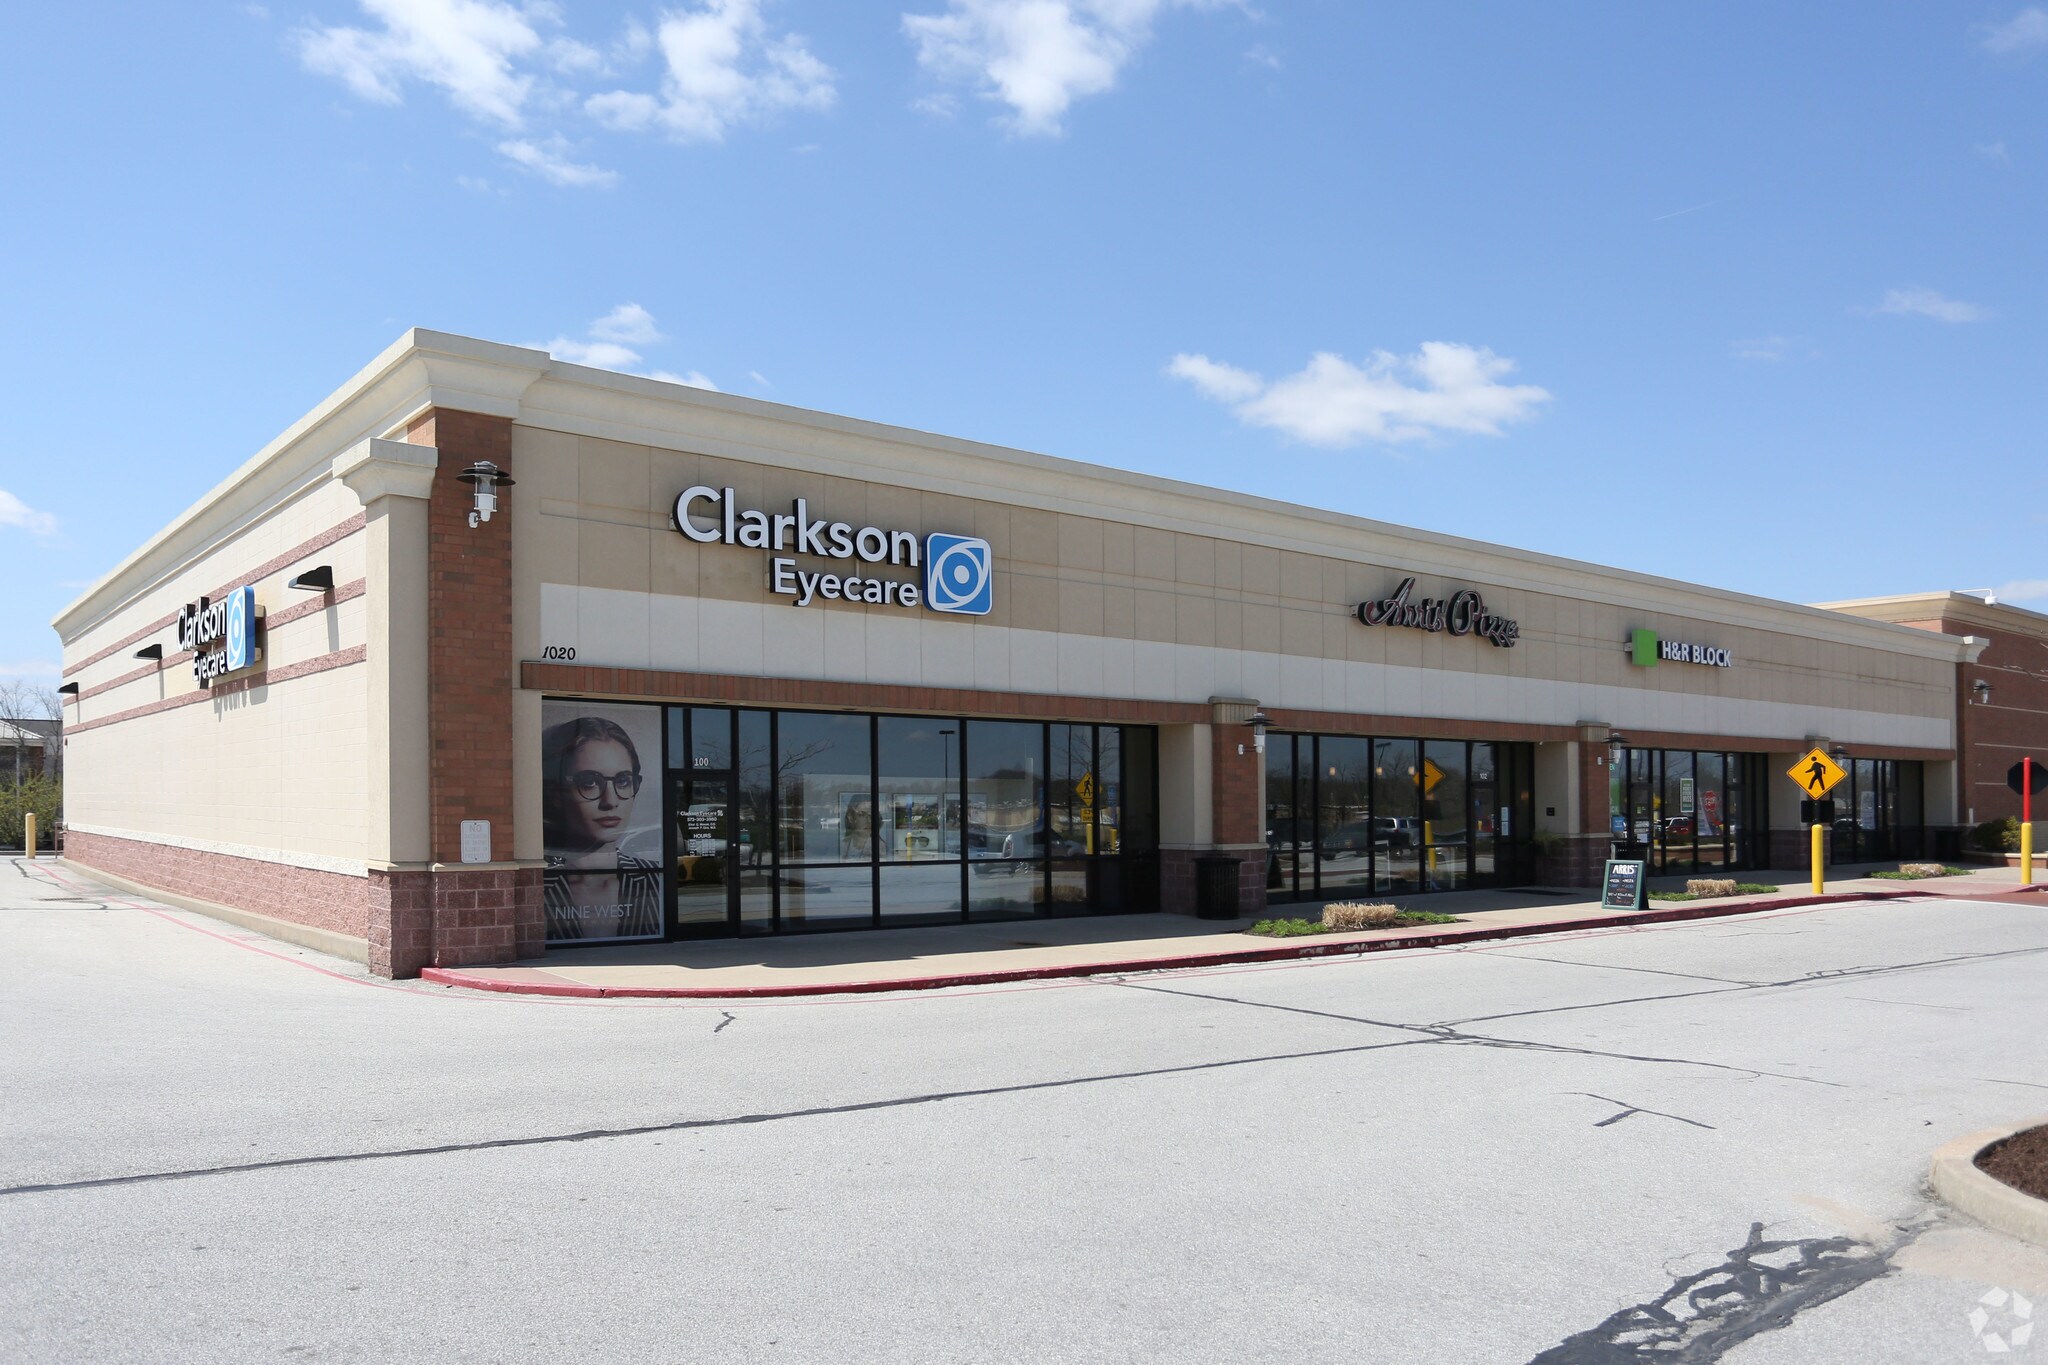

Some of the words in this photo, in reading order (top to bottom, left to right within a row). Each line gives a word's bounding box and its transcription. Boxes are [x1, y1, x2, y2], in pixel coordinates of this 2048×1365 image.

[674, 485, 919, 568] Clarkson
[772, 557, 919, 607] Eyecare
[177, 597, 226, 651] Clarkson
[1447, 589, 1520, 647] Pizza
[193, 650, 226, 690] Eyecare
[541, 646, 576, 660] 1020
[1662, 640, 1690, 662] H&R
[1692, 645, 1732, 667] BLOCK
[694, 757, 709, 767] 100
[555, 905, 591, 920] NINE
[594, 903, 633, 918] WEST
